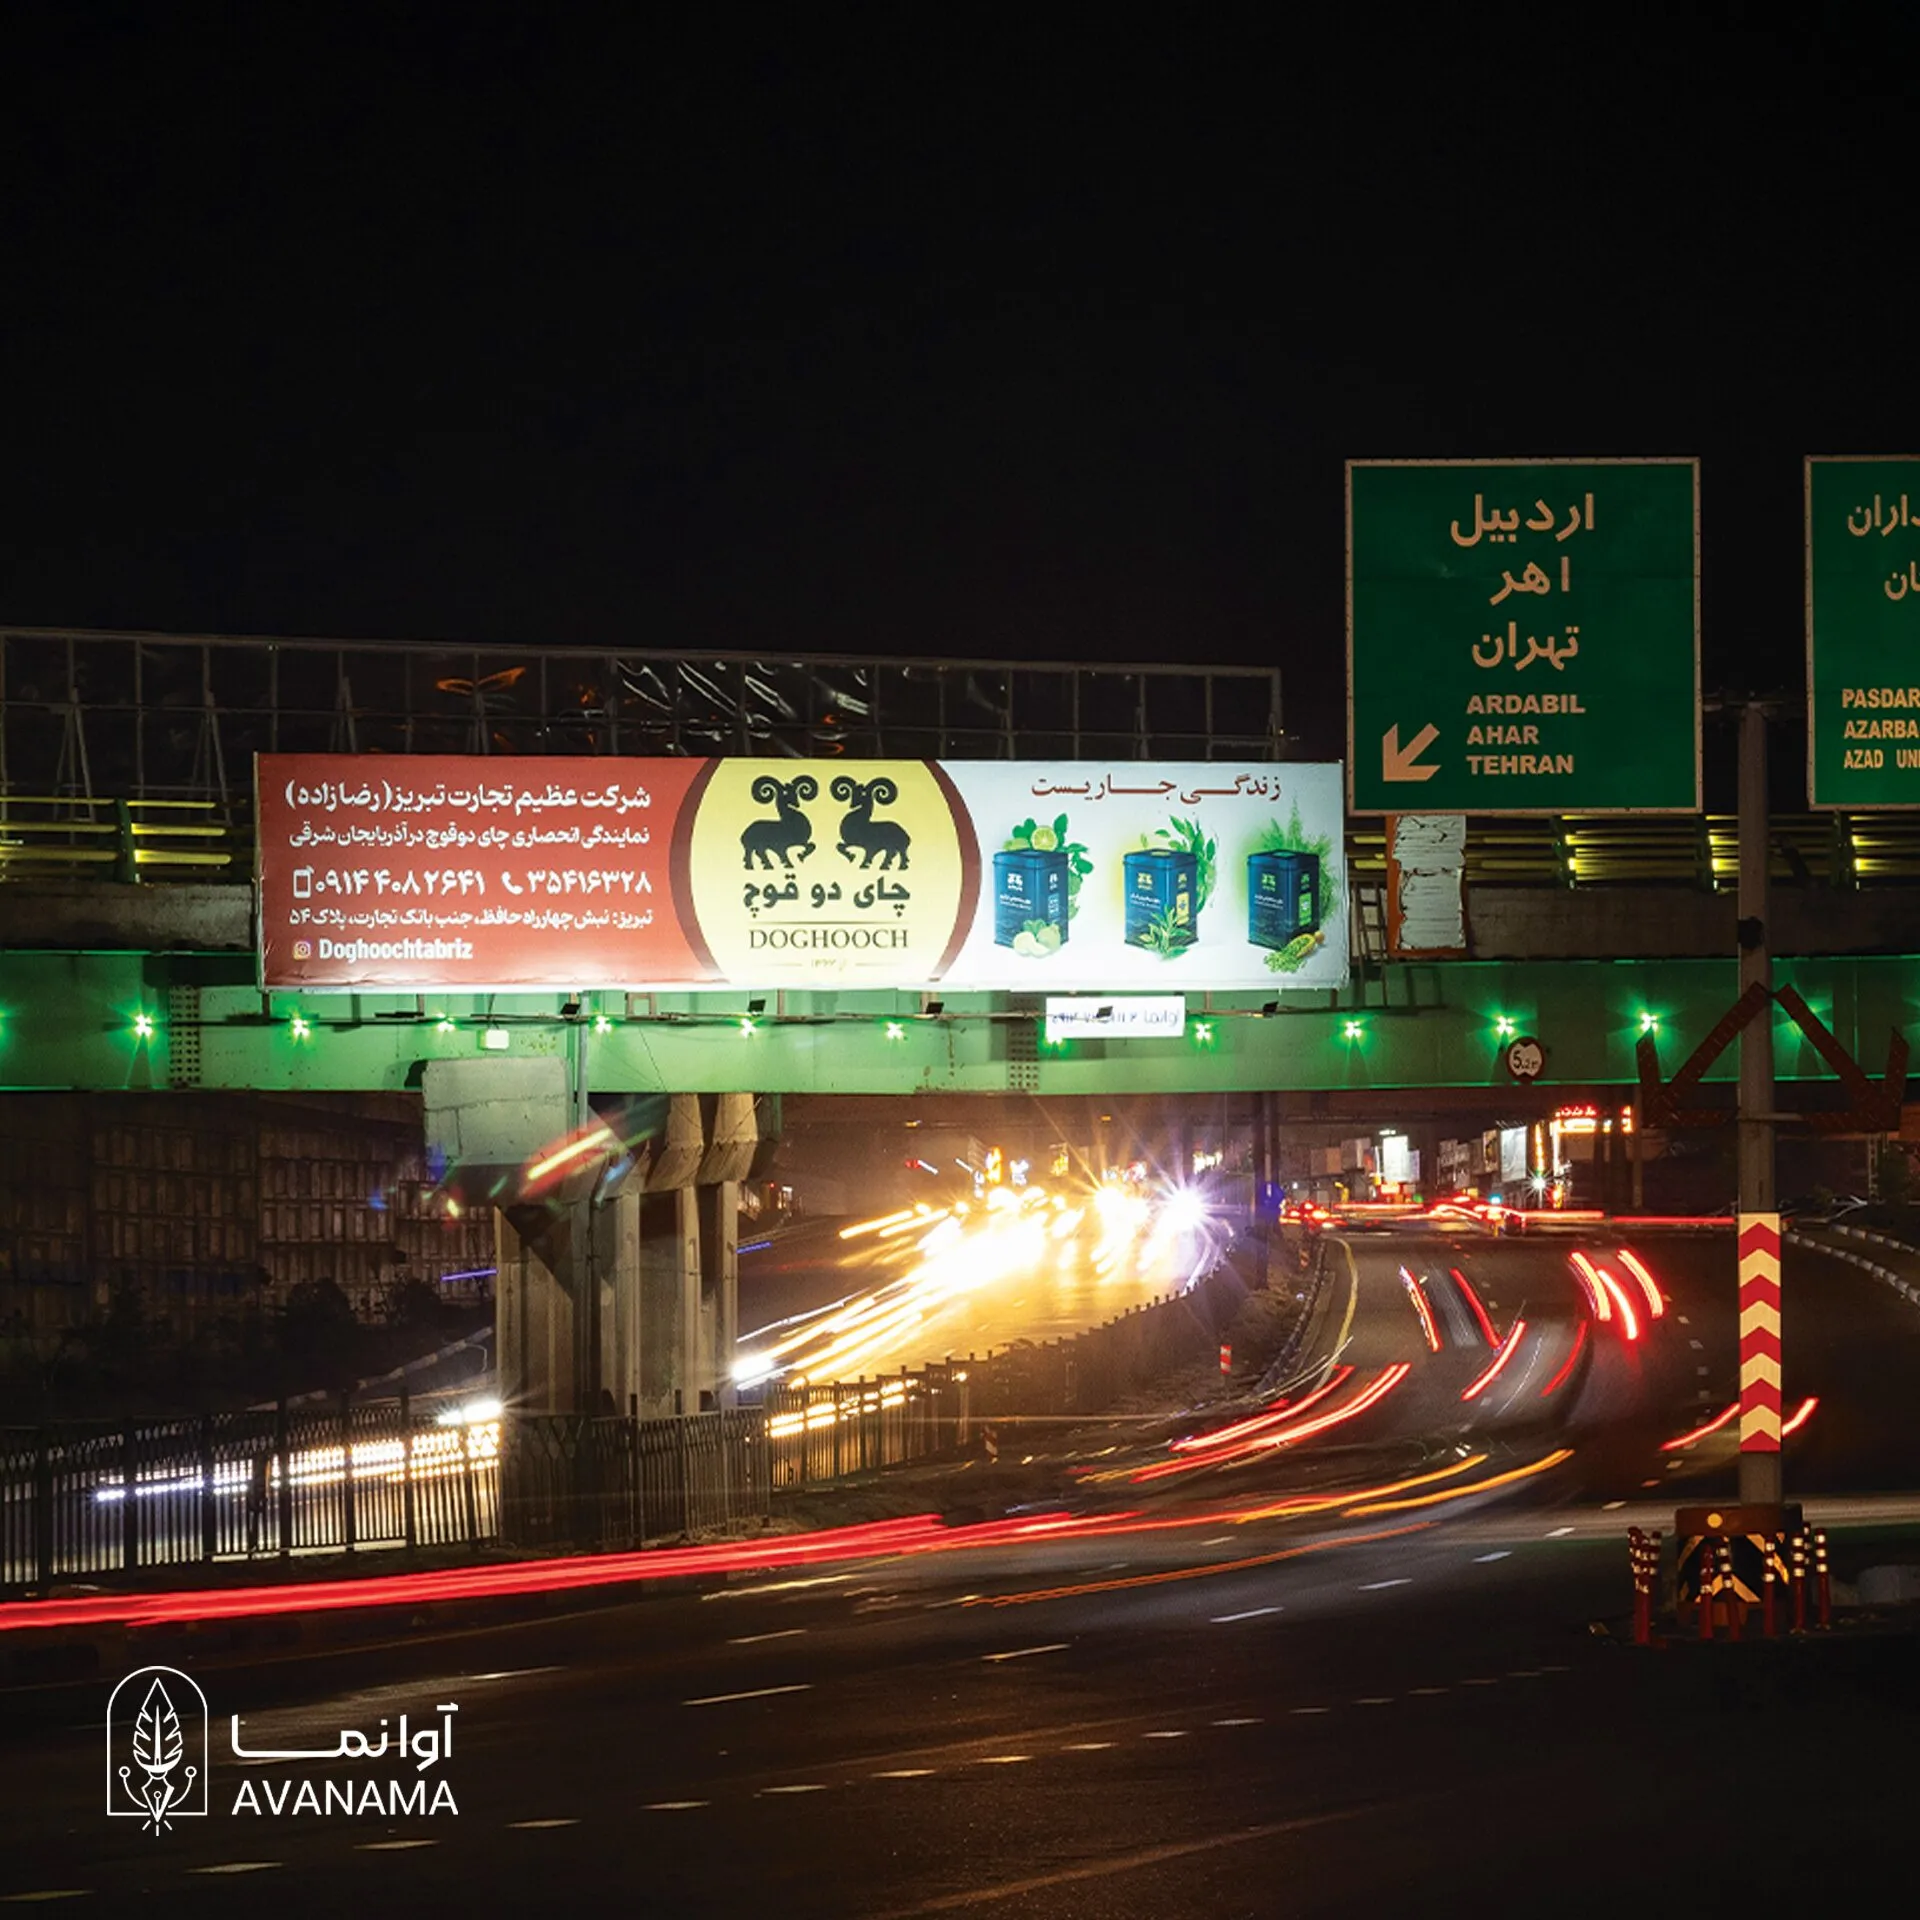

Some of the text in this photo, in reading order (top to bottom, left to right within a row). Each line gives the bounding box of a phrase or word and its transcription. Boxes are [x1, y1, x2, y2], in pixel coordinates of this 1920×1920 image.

[1450, 493, 1595, 547] اردبیل
[1490, 556, 1570, 605] اهر
[1471, 621, 1580, 671] تهران
[1466, 695, 1586, 715] ARDABIL
[1466, 725, 1540, 745] AHAR
[1466, 755, 1574, 775] TEHRAN
[1844, 750, 1884, 769] AZAD
[449, 783, 513, 813] تجارت
[515, 784, 577, 816] عظیم
[580, 784, 650, 814] شرکت
[1031, 772, 1282, 804] زندگی جاریست
[289, 821, 336, 847] شرقی
[477, 825, 510, 850] چای
[511, 825, 580, 848] انحصاری
[580, 825, 650, 849] نمایندگی
[743, 873, 911, 919] چای دو قوچ
[289, 909, 312, 925] ۵۴
[311, 908, 348, 931] پلاک
[400, 908, 434, 928] بانک
[434, 910, 474, 929] جنب
[573, 909, 610, 930] نبش
[318, 937, 473, 964] Doghoochtabriz
[749, 929, 909, 950] DOGHOOCH
